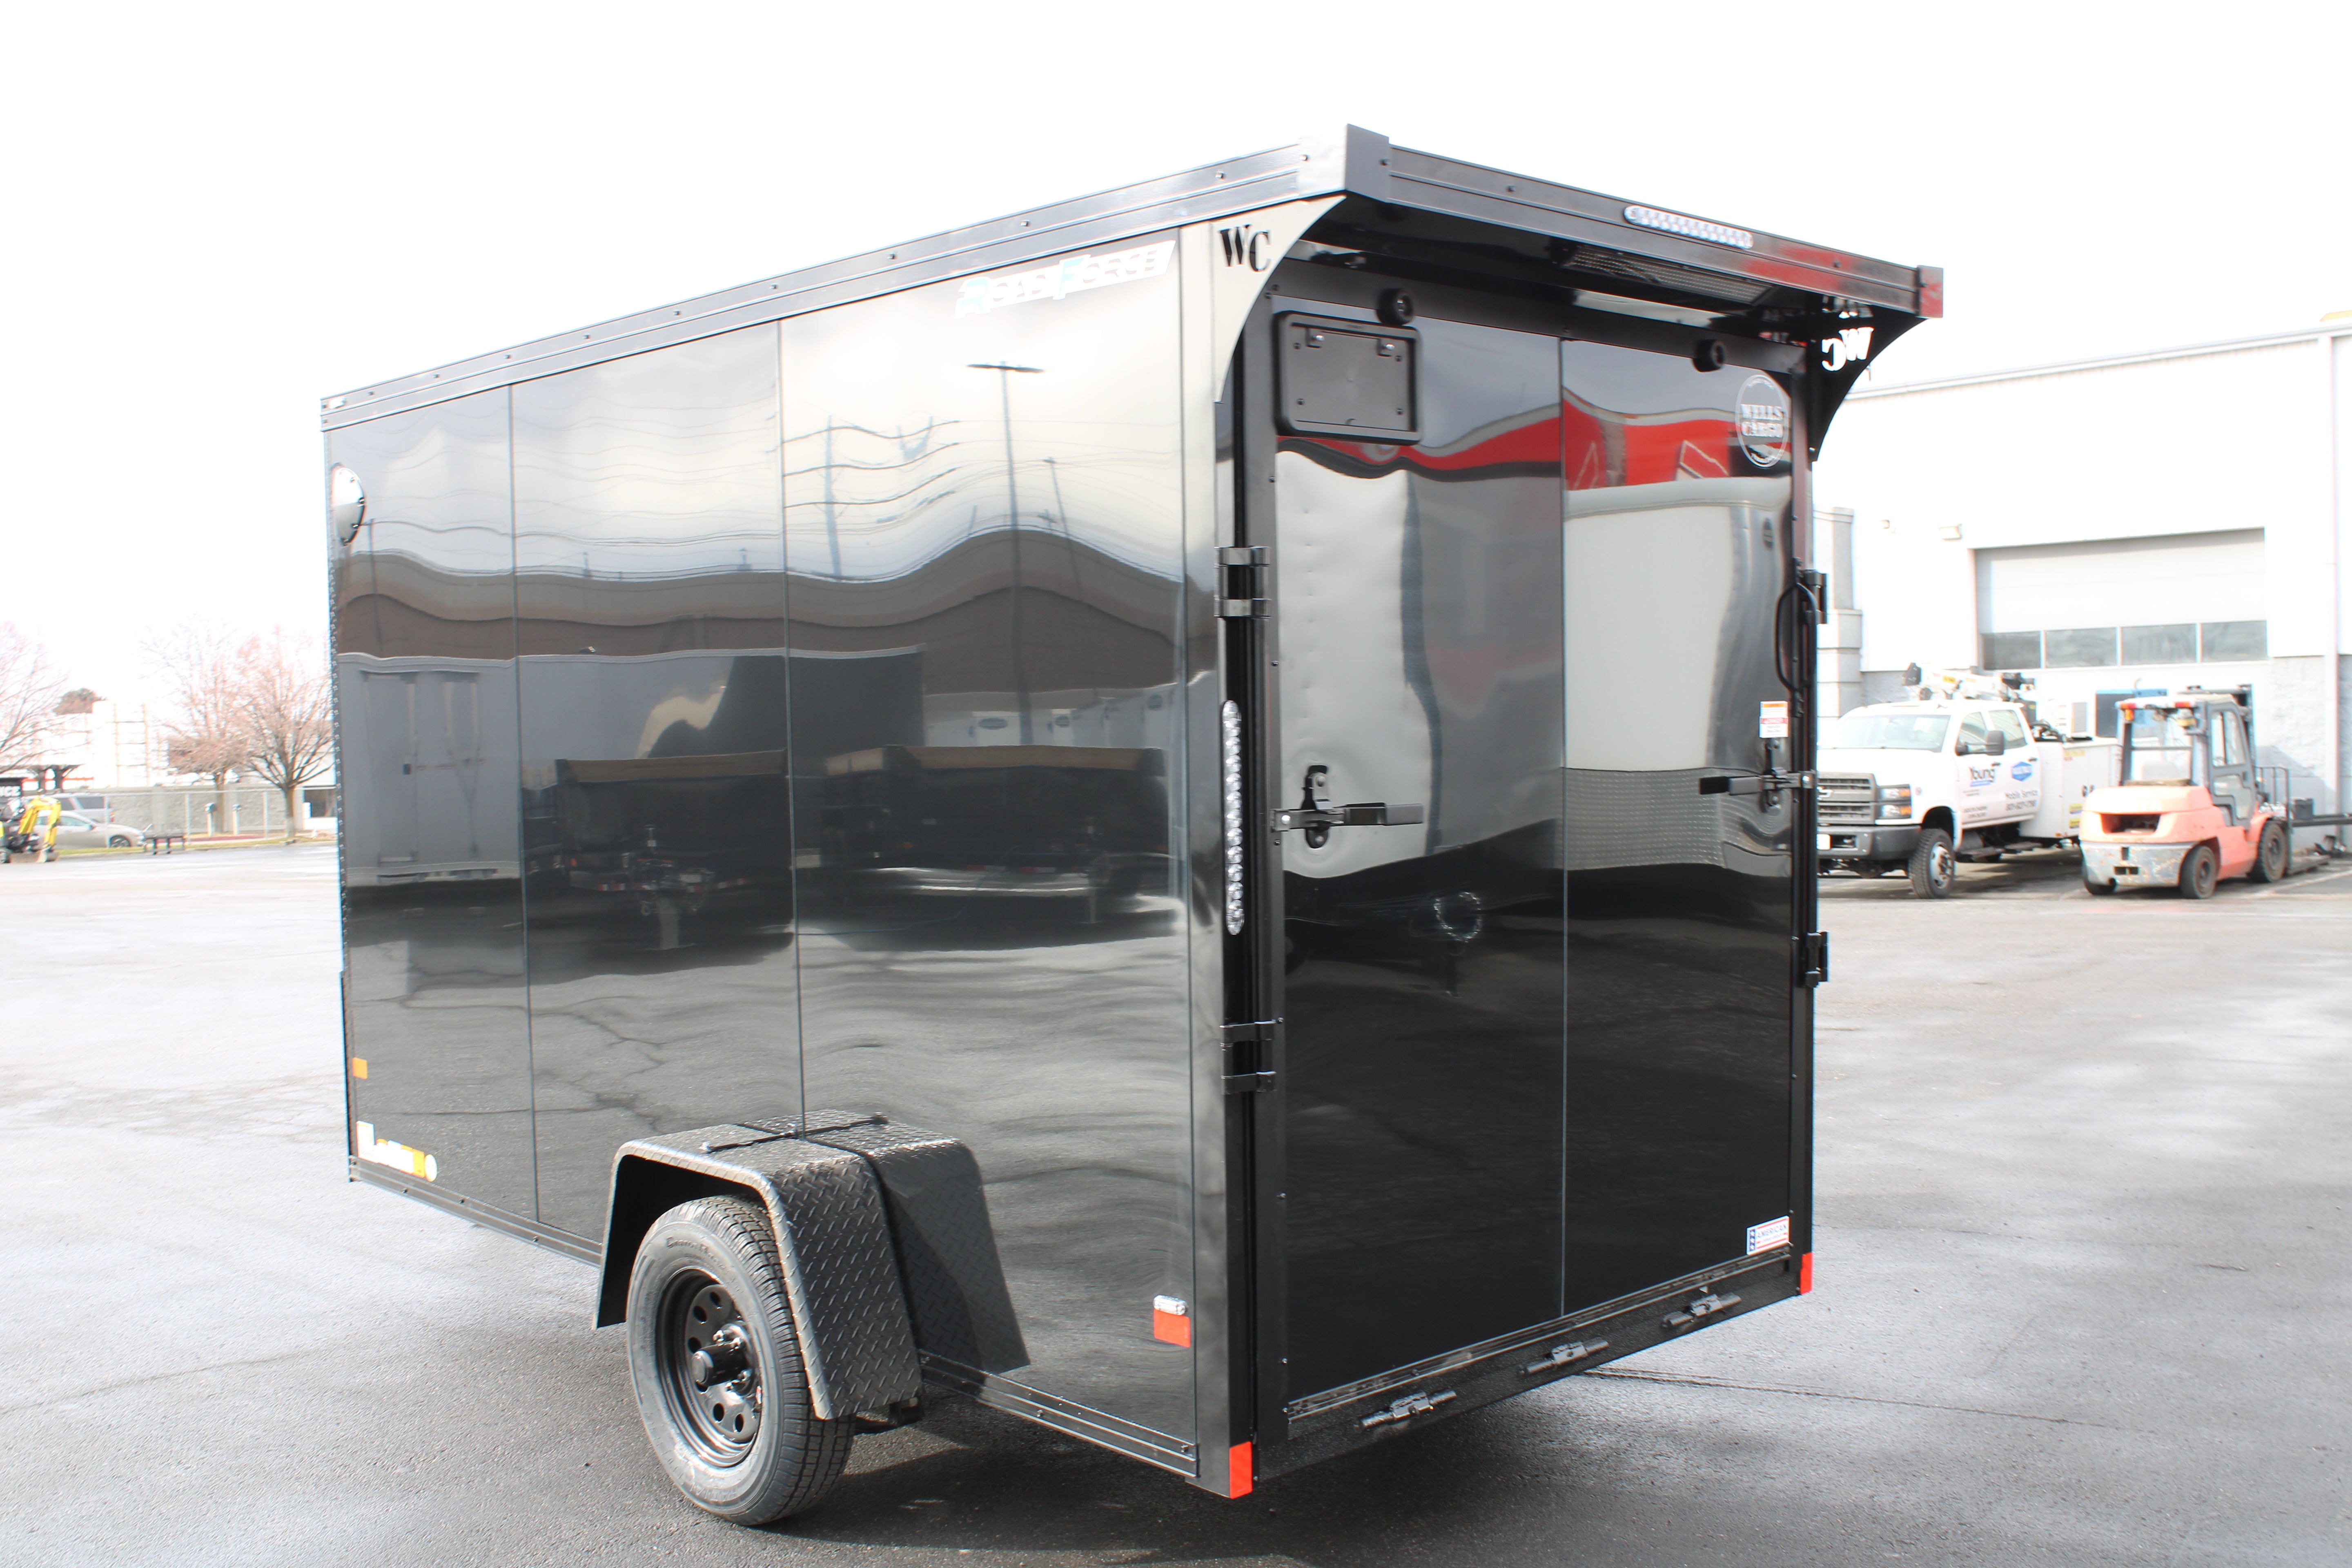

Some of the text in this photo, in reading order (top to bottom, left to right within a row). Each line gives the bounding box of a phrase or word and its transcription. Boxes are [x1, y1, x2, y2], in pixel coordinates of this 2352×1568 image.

[1218, 223, 1272, 273] WC
[1741, 403, 1784, 421] WELLS
[1741, 421, 1784, 438] CARGO
[1969, 766, 1995, 783] Young
